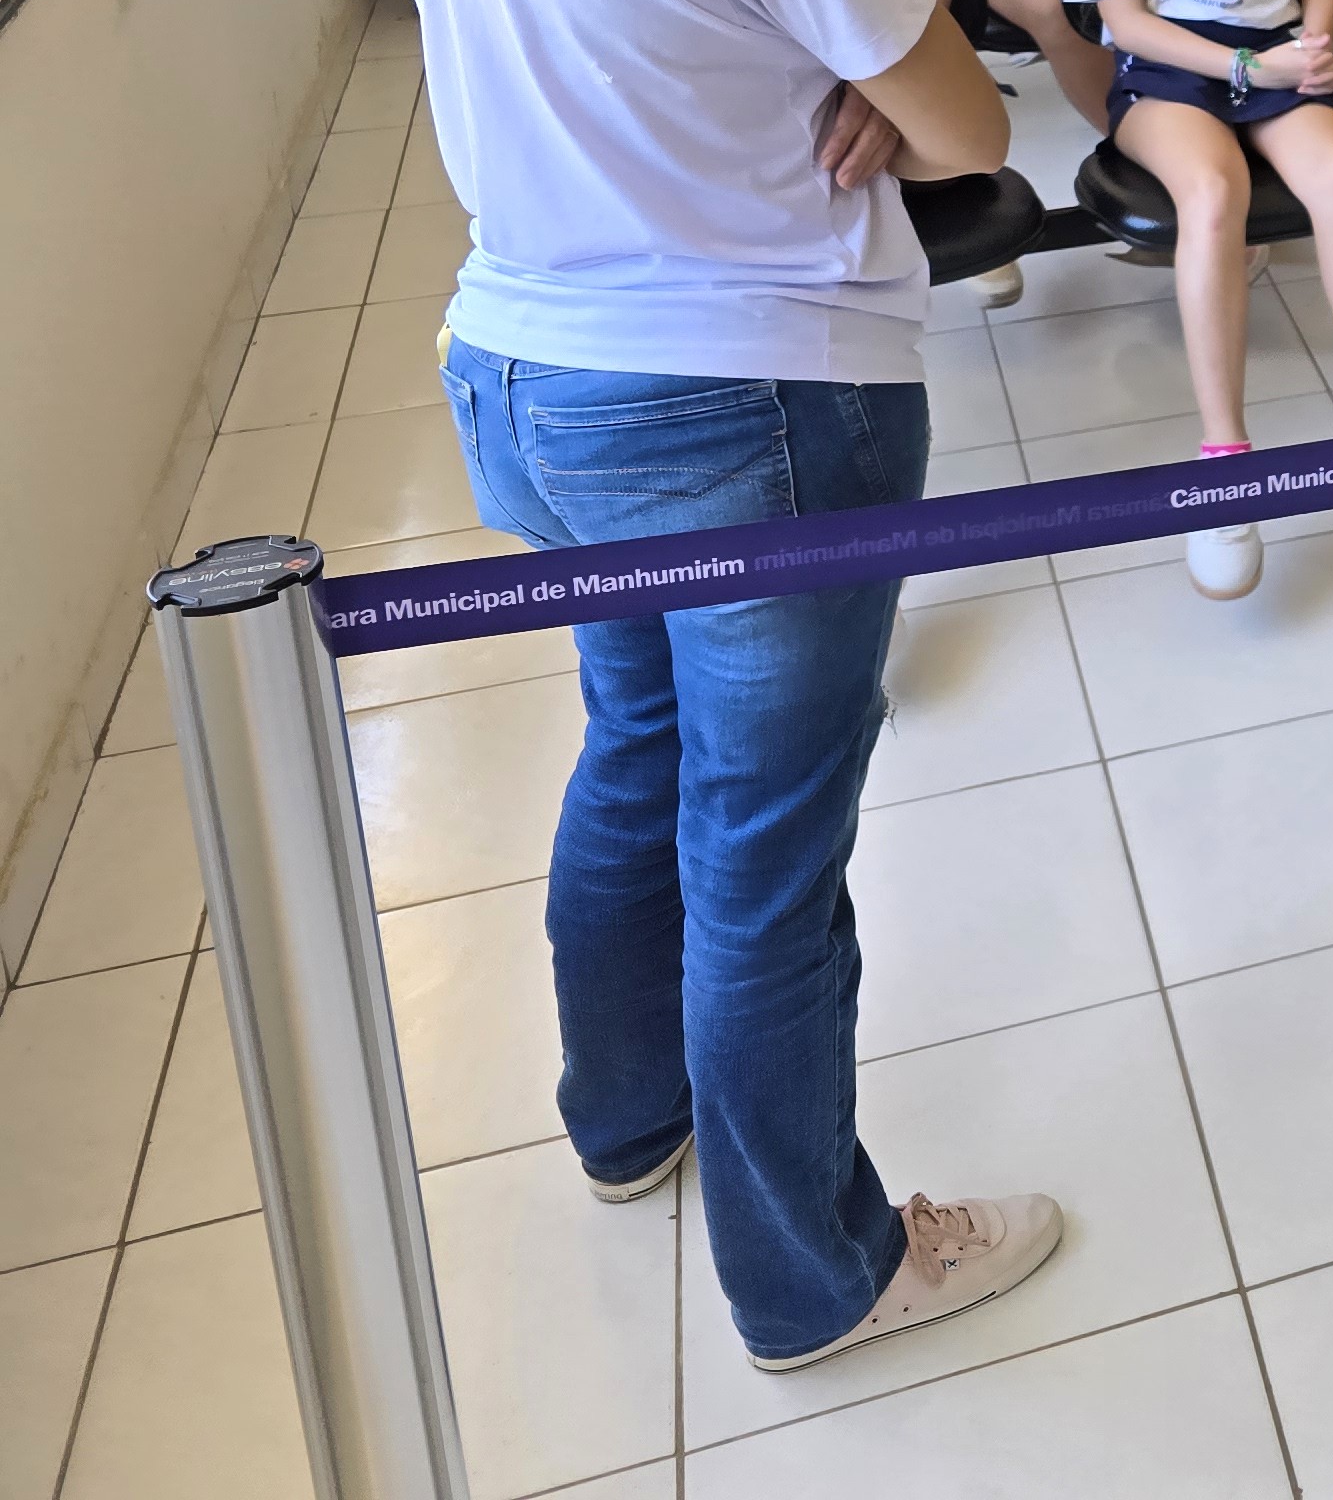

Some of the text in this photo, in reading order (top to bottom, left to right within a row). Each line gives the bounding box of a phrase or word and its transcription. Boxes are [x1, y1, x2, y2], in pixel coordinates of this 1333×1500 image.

[1170, 481, 1262, 509] Câmara
[168, 561, 283, 587] easyline
[384, 584, 524, 622] Municipal
[531, 578, 566, 601] de
[573, 557, 746, 597] Manhumirim
